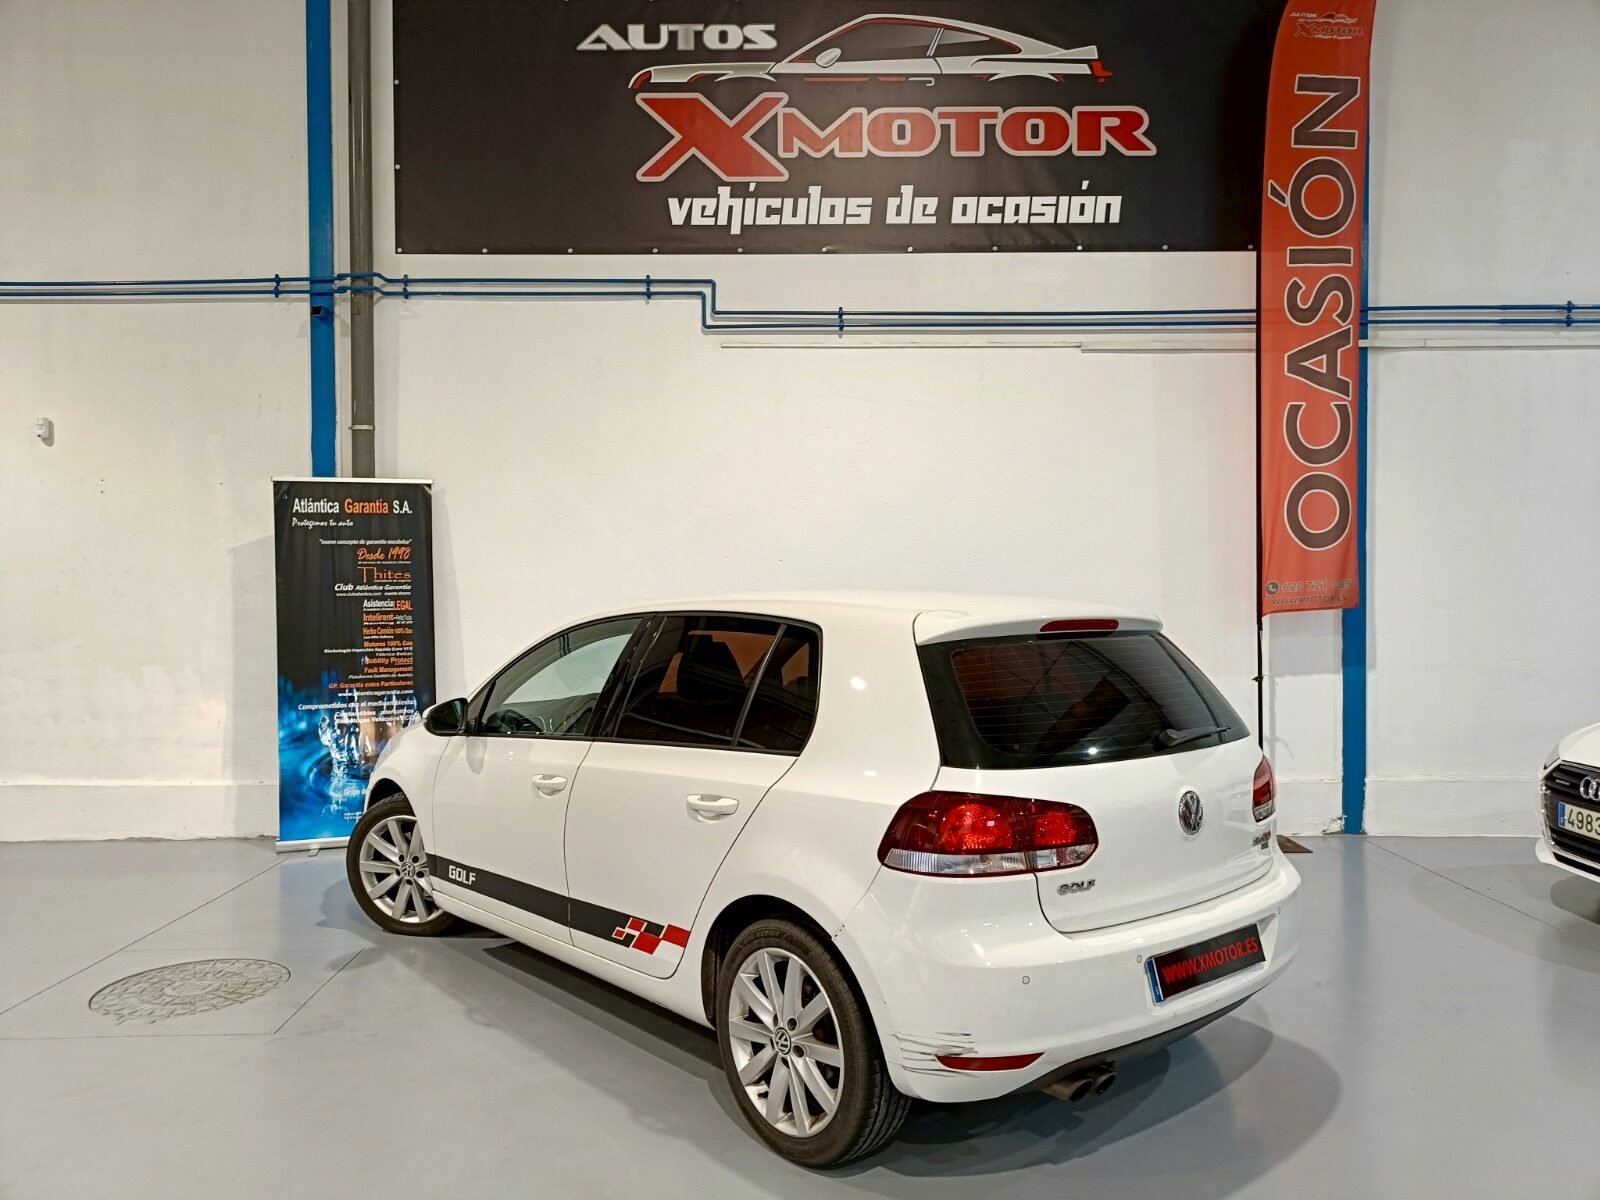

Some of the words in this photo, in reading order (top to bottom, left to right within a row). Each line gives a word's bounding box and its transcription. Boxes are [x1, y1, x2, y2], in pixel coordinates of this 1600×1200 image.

[577, 23, 777, 51] AUTOS
[636, 91, 1156, 183] XMOTOR
[886, 185, 936, 225] de
[952, 180, 1122, 225] ocasión
[1268, 74, 1360, 550] OCASIÓN
[292, 498, 339, 513] Atlántica
[344, 498, 389, 513] Garantía
[393, 500, 412, 514] S.A.
[357, 547, 385, 559] Desde
[388, 546, 411, 559] 1998
[334, 583, 353, 591] Club
[298, 703, 347, 711] Comprometidos
[1567, 808, 1600, 836] 4983
[448, 865, 476, 886] GOLF
[1057, 879, 1096, 896] GOLF
[1162, 936, 1259, 984] WWW.XMOTOR.ES
